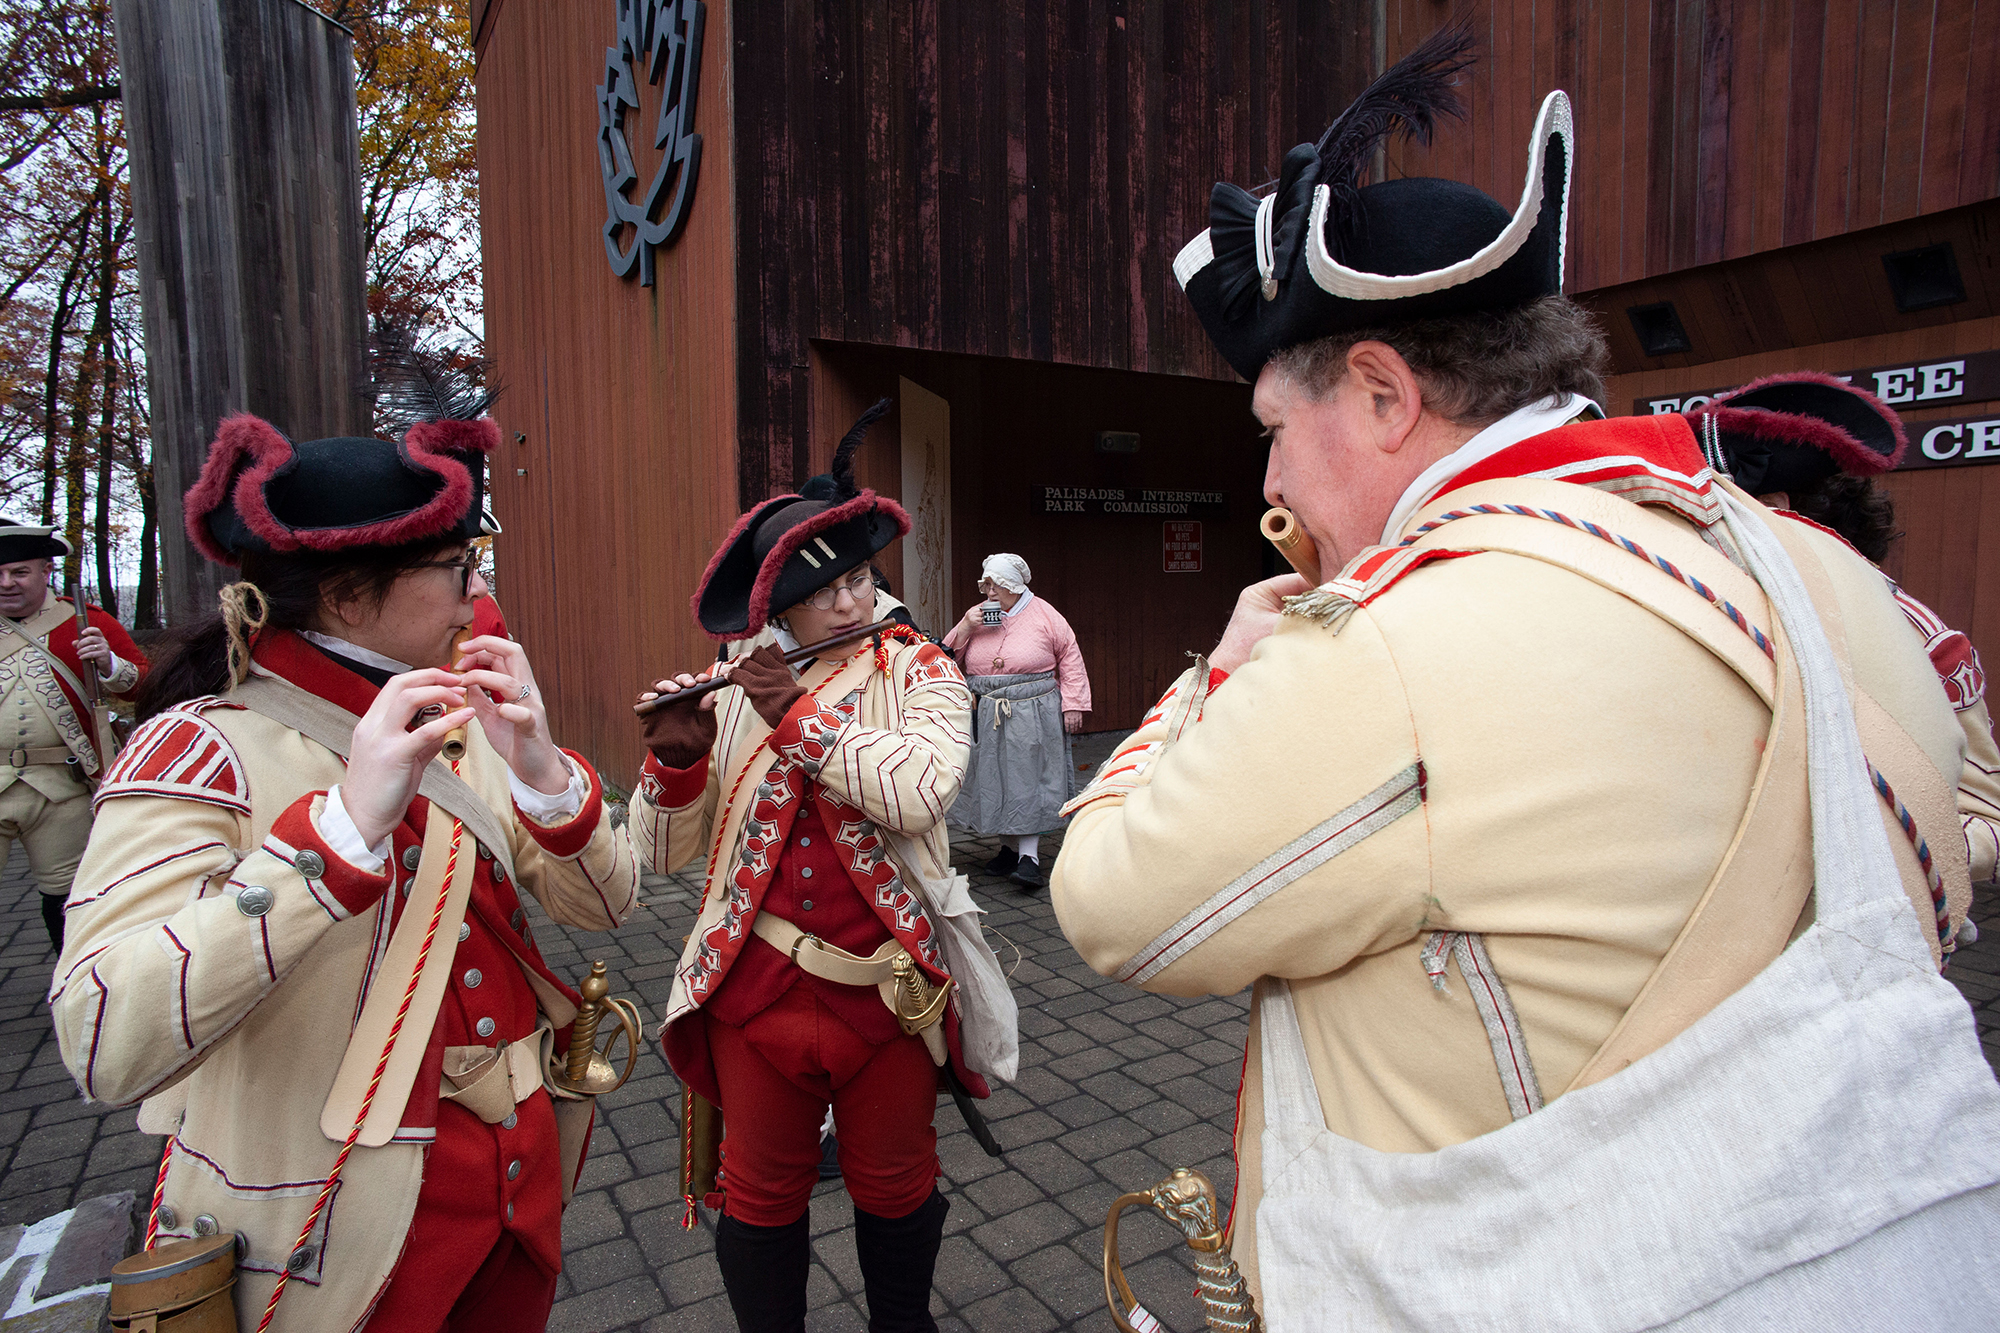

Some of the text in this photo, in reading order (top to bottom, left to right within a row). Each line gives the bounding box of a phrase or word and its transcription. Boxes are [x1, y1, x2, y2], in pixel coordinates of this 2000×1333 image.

[1837, 360, 1965, 404] EE
[1045, 487, 1222, 503] PALISADES INTERSTATE
[1045, 500, 1189, 514] PARK COMMISSION
